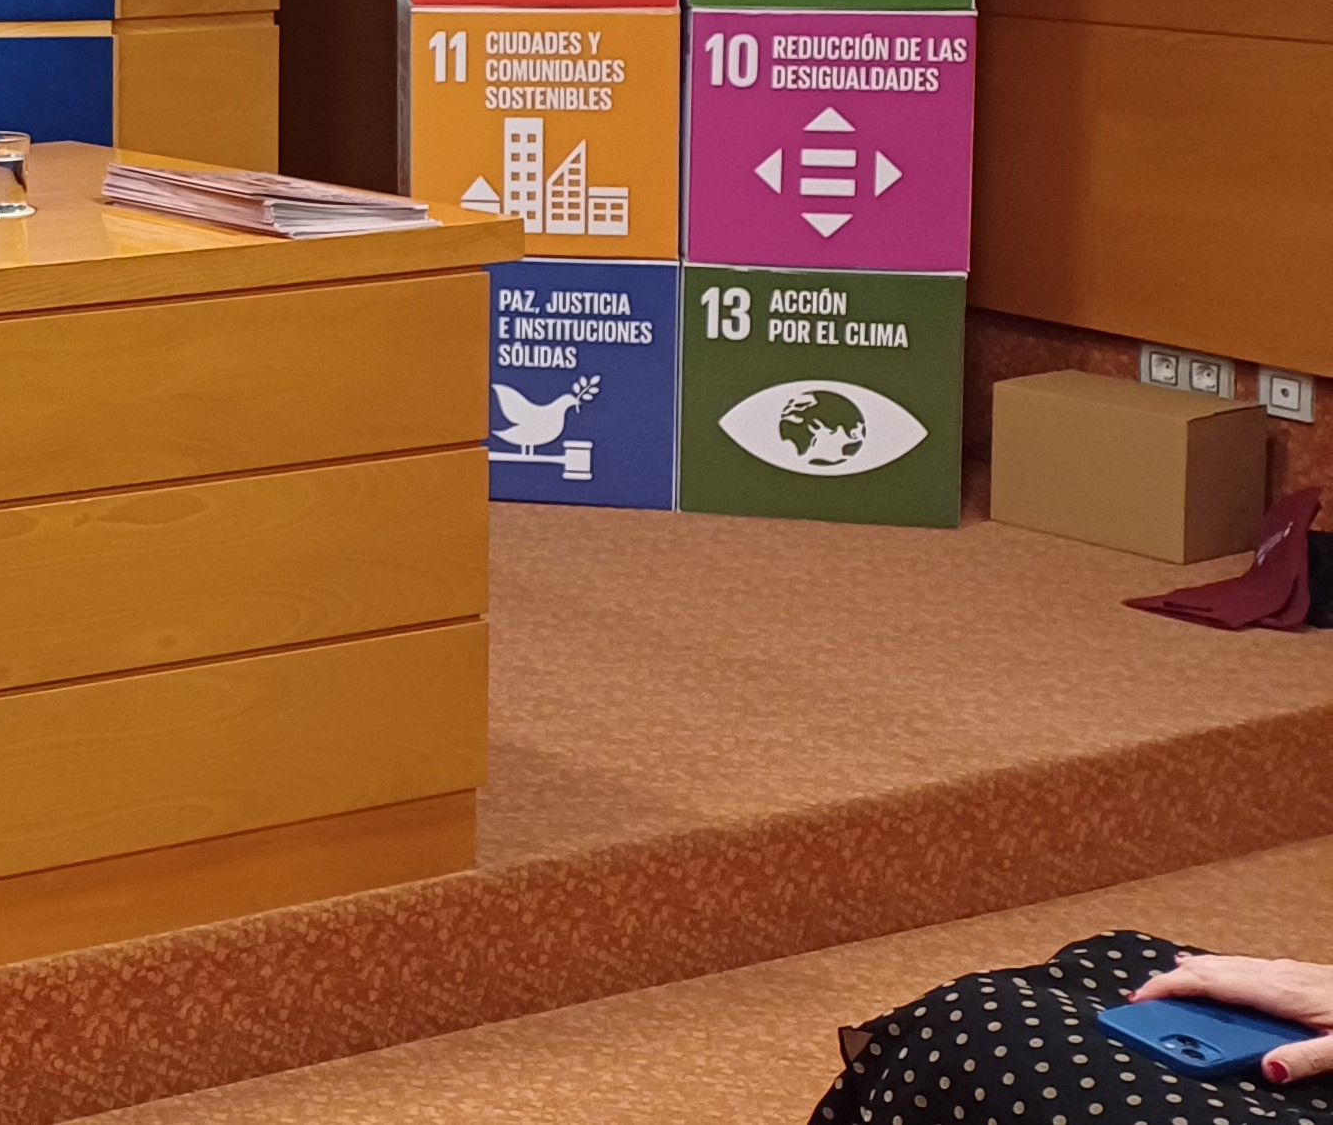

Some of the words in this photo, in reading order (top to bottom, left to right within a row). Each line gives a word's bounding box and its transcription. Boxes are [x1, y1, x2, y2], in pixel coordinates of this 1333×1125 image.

[428, 30, 468, 83] 11
[484, 30, 582, 55] CIUDADES
[586, 31, 602, 55] Y
[772, 31, 890, 61] REDUCCIÓN
[894, 35, 922, 62] DE
[928, 37, 968, 62] LAS
[484, 58, 625, 84] COMUNIDADES
[704, 32, 760, 88] 10
[771, 64, 940, 92] DESIGUALDADES
[484, 85, 613, 111] SOSTENIBLES
[498, 290, 541, 318] PAZ,
[546, 290, 632, 316] JUSTICIA
[700, 286, 752, 341] 13
[768, 286, 848, 316] ACCIÓN
[498, 316, 511, 340] E
[514, 317, 653, 345] INSTITUCIONES
[768, 319, 811, 346] POR
[816, 321, 840, 346] EL
[844, 322, 910, 349] CLIMA
[497, 342, 578, 369] SÓLIDAS
